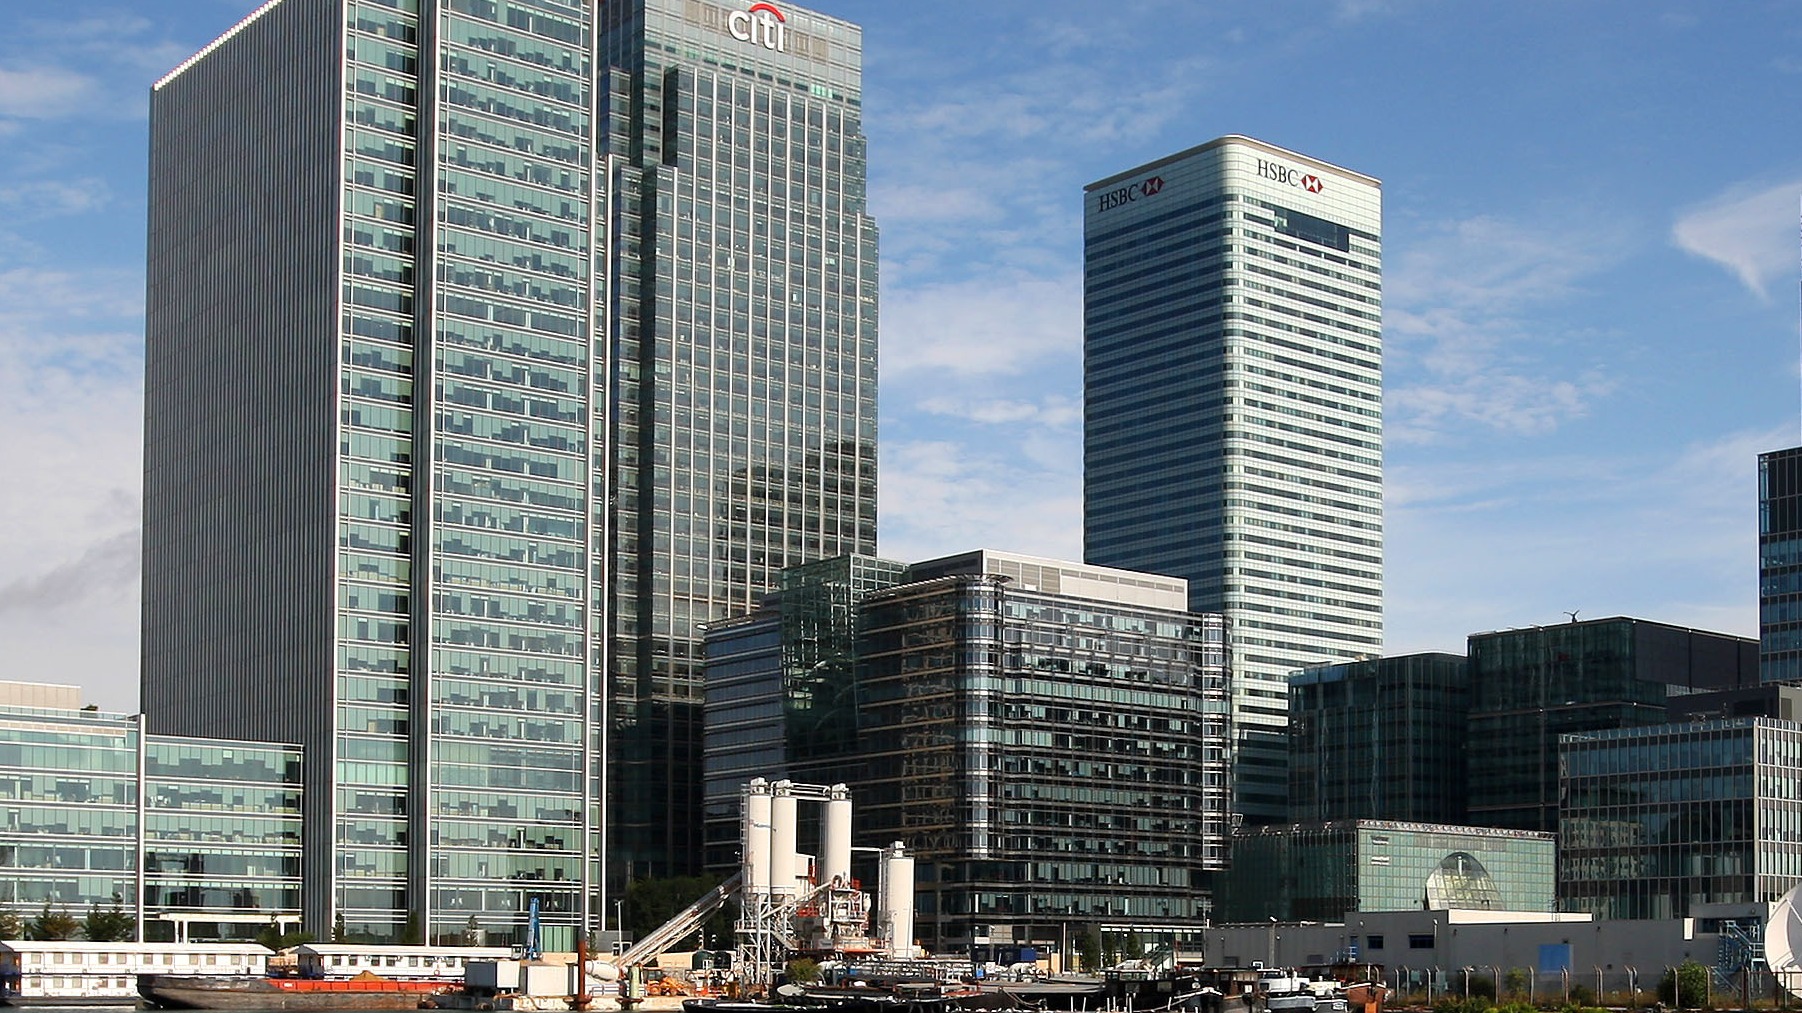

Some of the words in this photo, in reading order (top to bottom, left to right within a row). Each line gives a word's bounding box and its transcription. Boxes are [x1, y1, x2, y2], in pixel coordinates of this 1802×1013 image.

[728, 3, 785, 53] citi
[1257, 158, 1299, 187] HSBC
[1098, 184, 1139, 213] HSBC
